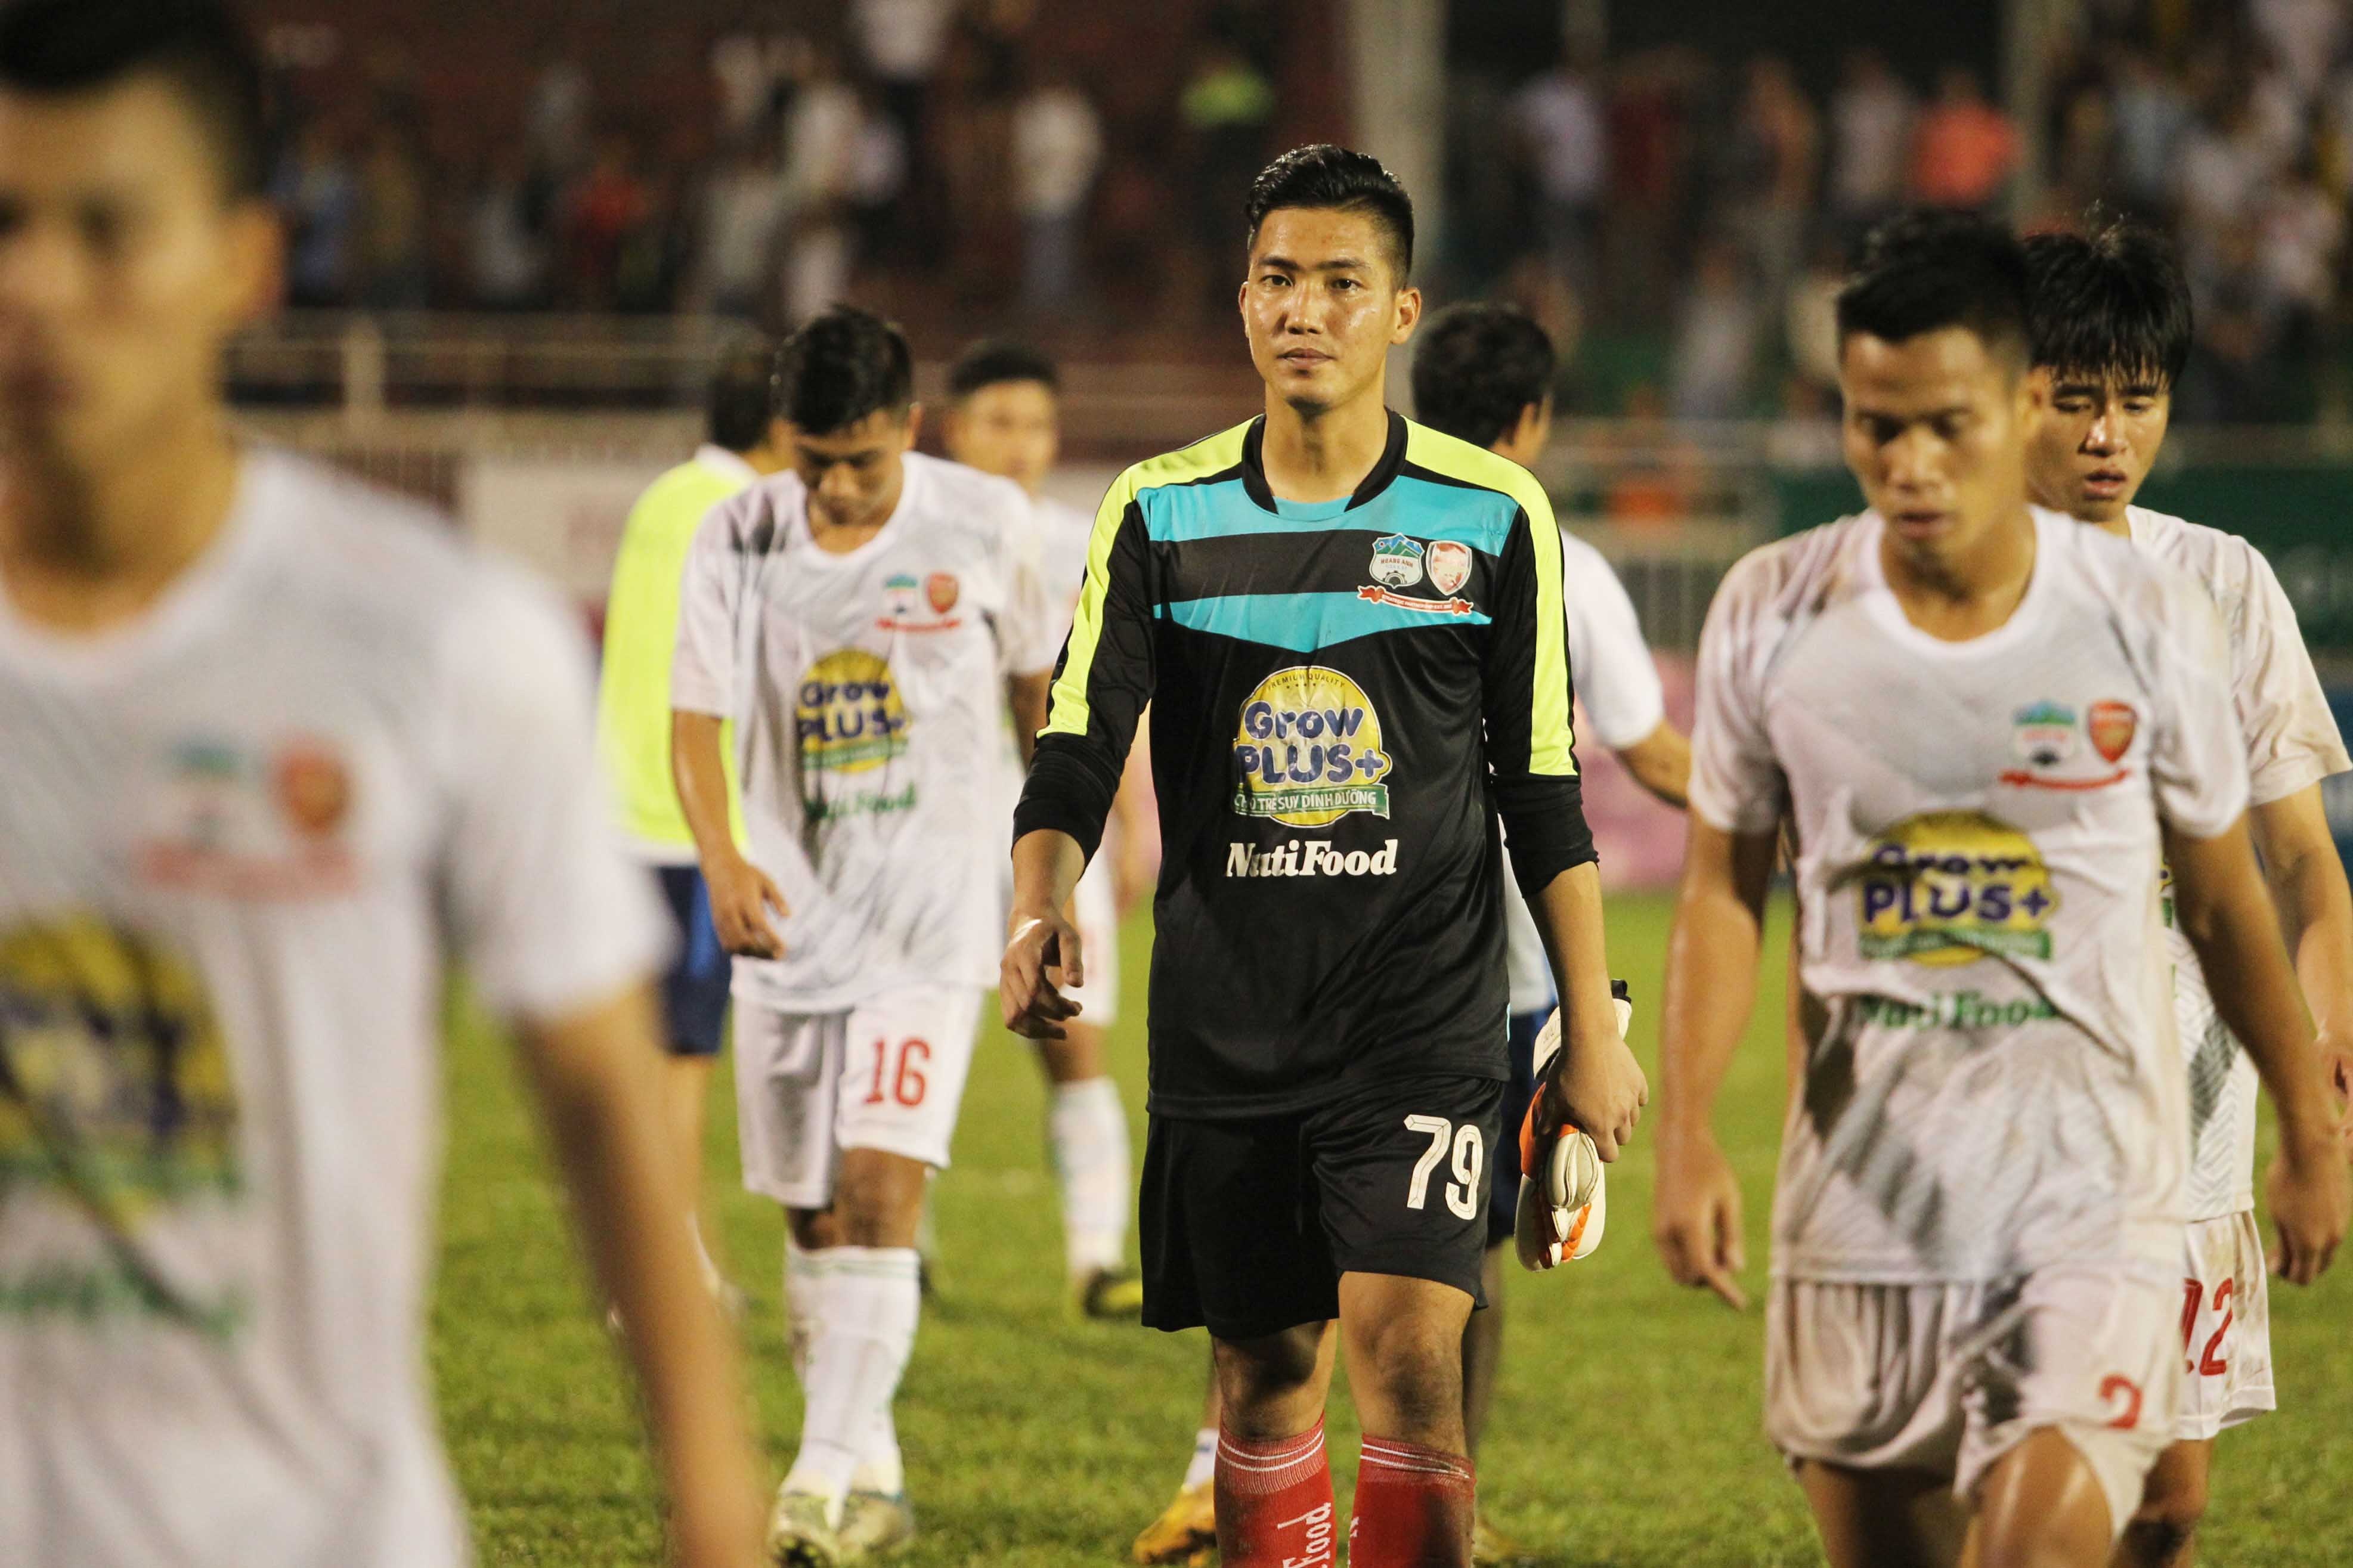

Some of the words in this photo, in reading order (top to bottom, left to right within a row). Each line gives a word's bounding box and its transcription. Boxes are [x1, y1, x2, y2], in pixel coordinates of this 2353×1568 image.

[1307, 673, 1345, 687] QUALITY
[1234, 743, 1385, 784] PLUS+
[1234, 794, 1254, 810] CO
[1278, 795, 1299, 810] SUY
[1225, 839, 1398, 877] NutiFood
[863, 1037, 931, 1108] 16
[1403, 1114, 1484, 1220] 79
[2180, 1278, 2233, 1376] 12
[2098, 1373, 2143, 1430] 2
